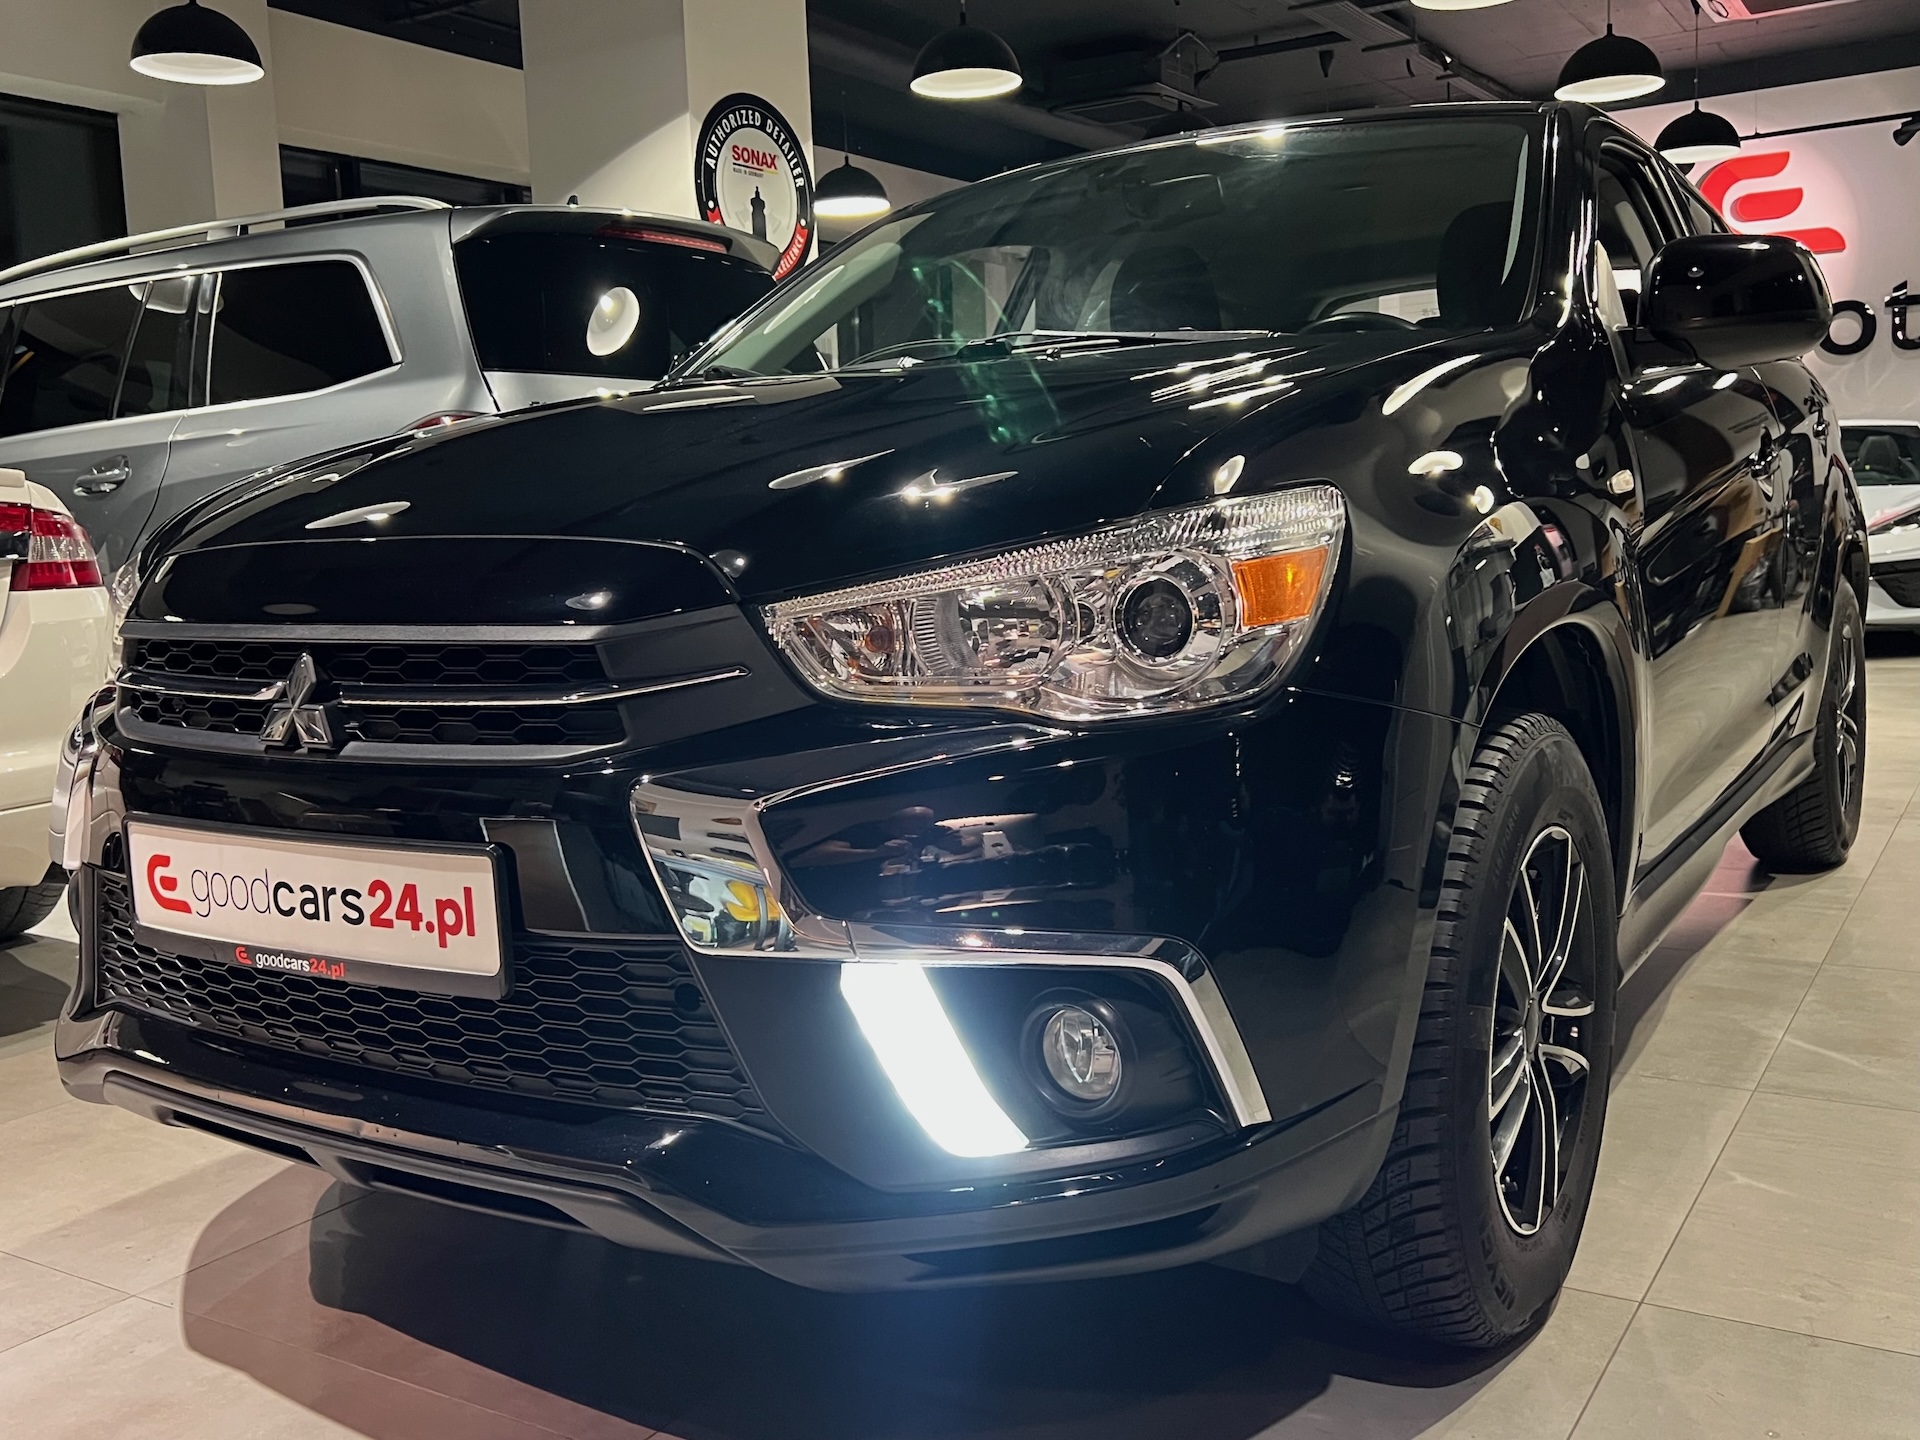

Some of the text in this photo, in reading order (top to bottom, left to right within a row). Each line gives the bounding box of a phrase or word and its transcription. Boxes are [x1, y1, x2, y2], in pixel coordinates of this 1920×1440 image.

[705, 110, 805, 187] AUTHORIZED DETAILER
[732, 144, 777, 170] SONAX
[772, 233, 804, 281] CELLENCE
[191, 868, 476, 948] goodcars24.pl
[256, 953, 345, 979] goodcars24.pl
